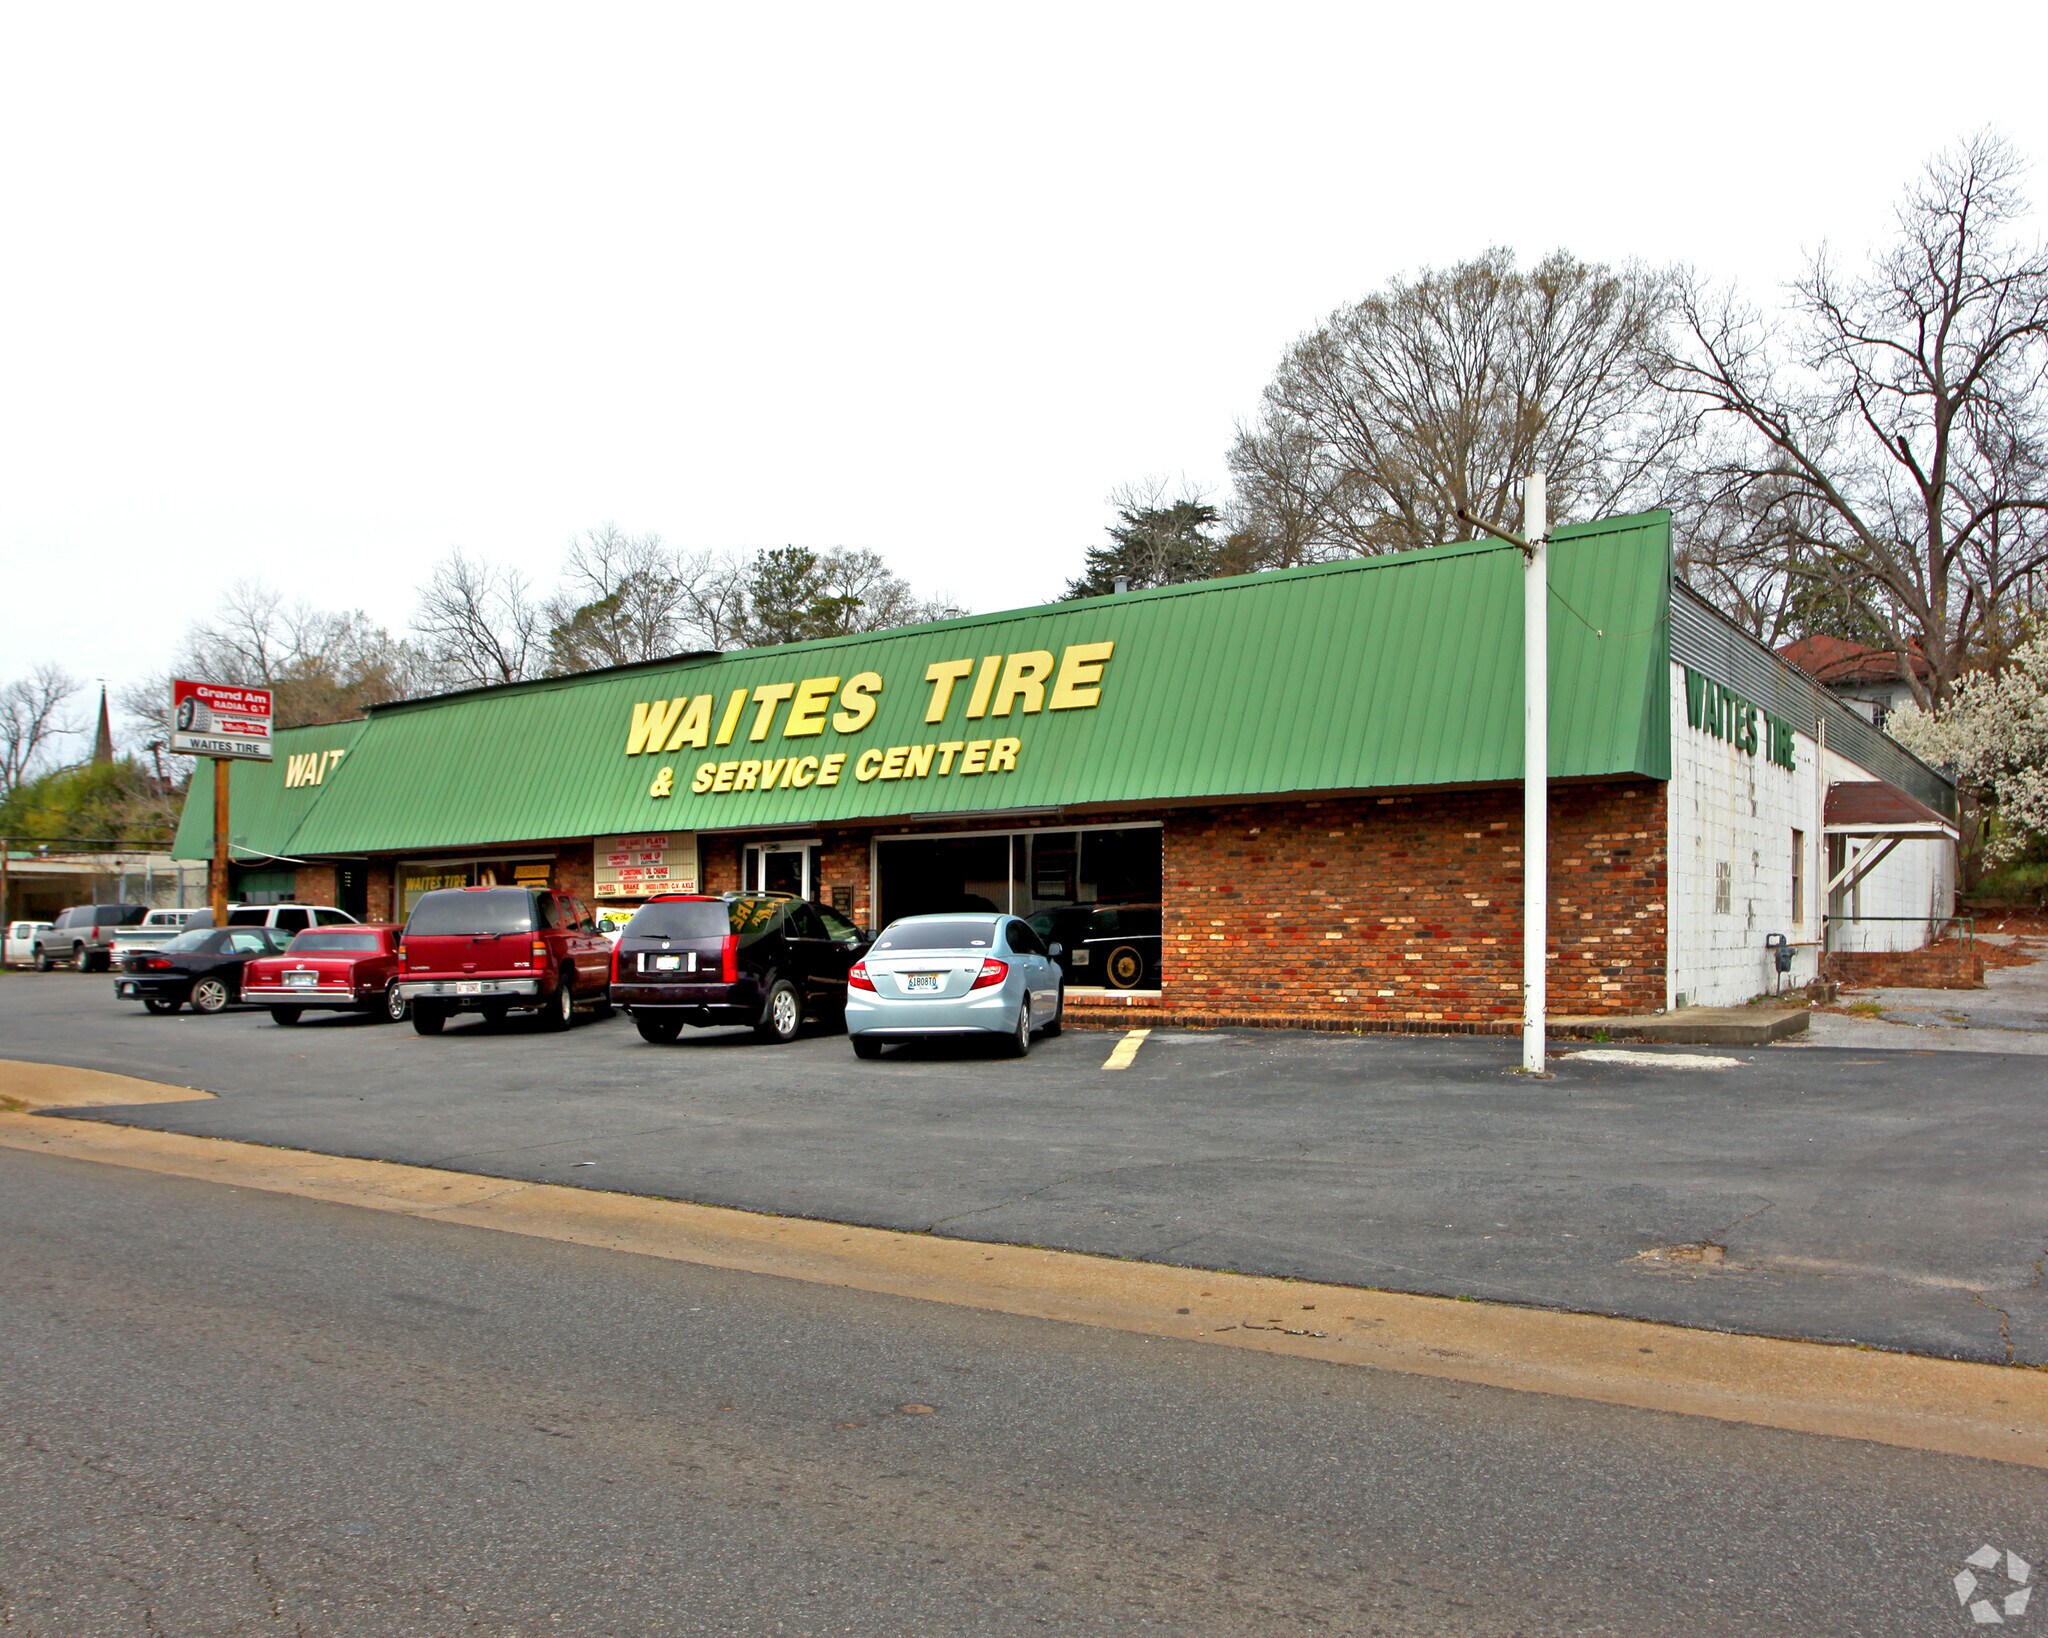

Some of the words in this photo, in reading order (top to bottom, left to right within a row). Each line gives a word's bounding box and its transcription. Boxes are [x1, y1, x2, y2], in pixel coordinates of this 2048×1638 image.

[196, 686, 243, 701] Grand
[245, 692, 268, 704] Am
[626, 672, 884, 756] WAITES
[924, 641, 1116, 724] TIRE
[213, 700, 249, 712] RADIAL
[1684, 665, 1758, 758] WAITES
[1763, 710, 1797, 771] TIRE
[189, 739, 233, 752] WAITES
[235, 743, 261, 754] TIRE
[649, 766, 674, 798] &
[691, 752, 848, 793] SERVICE
[855, 737, 1022, 782] CENTER
[647, 837, 666, 845] FLATS
[640, 853, 653, 861] TUNE
[654, 852, 662, 860] UP
[653, 867, 669, 875] CHANGE
[405, 876, 441, 891] WAITES
[444, 875, 467, 887] TIRE
[598, 884, 616, 892] WHEEL
[681, 881, 695, 889] AXLE
